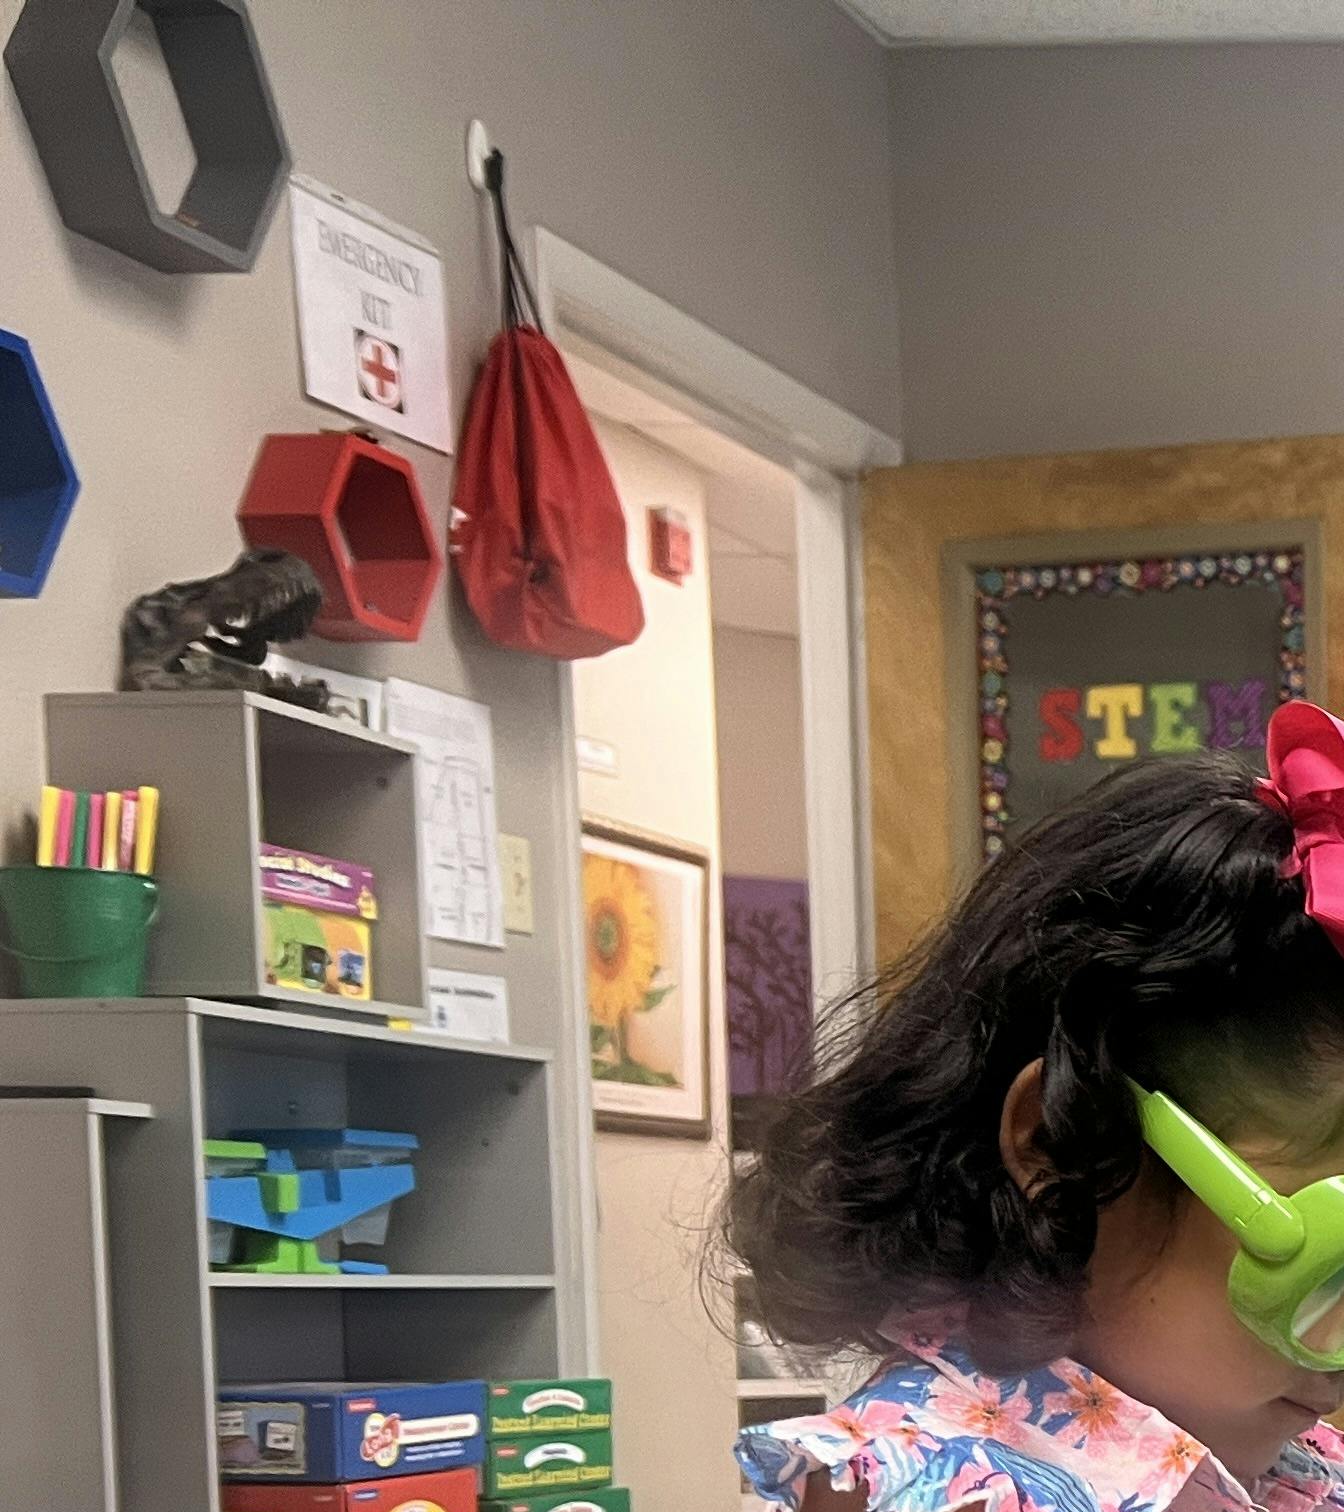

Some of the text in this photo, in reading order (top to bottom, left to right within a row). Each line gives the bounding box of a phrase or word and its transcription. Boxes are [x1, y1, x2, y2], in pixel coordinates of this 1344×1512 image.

[317, 218, 422, 298] EMERGENCY
[360, 289, 393, 330] KIT
[1039, 682, 1267, 762] STEM
